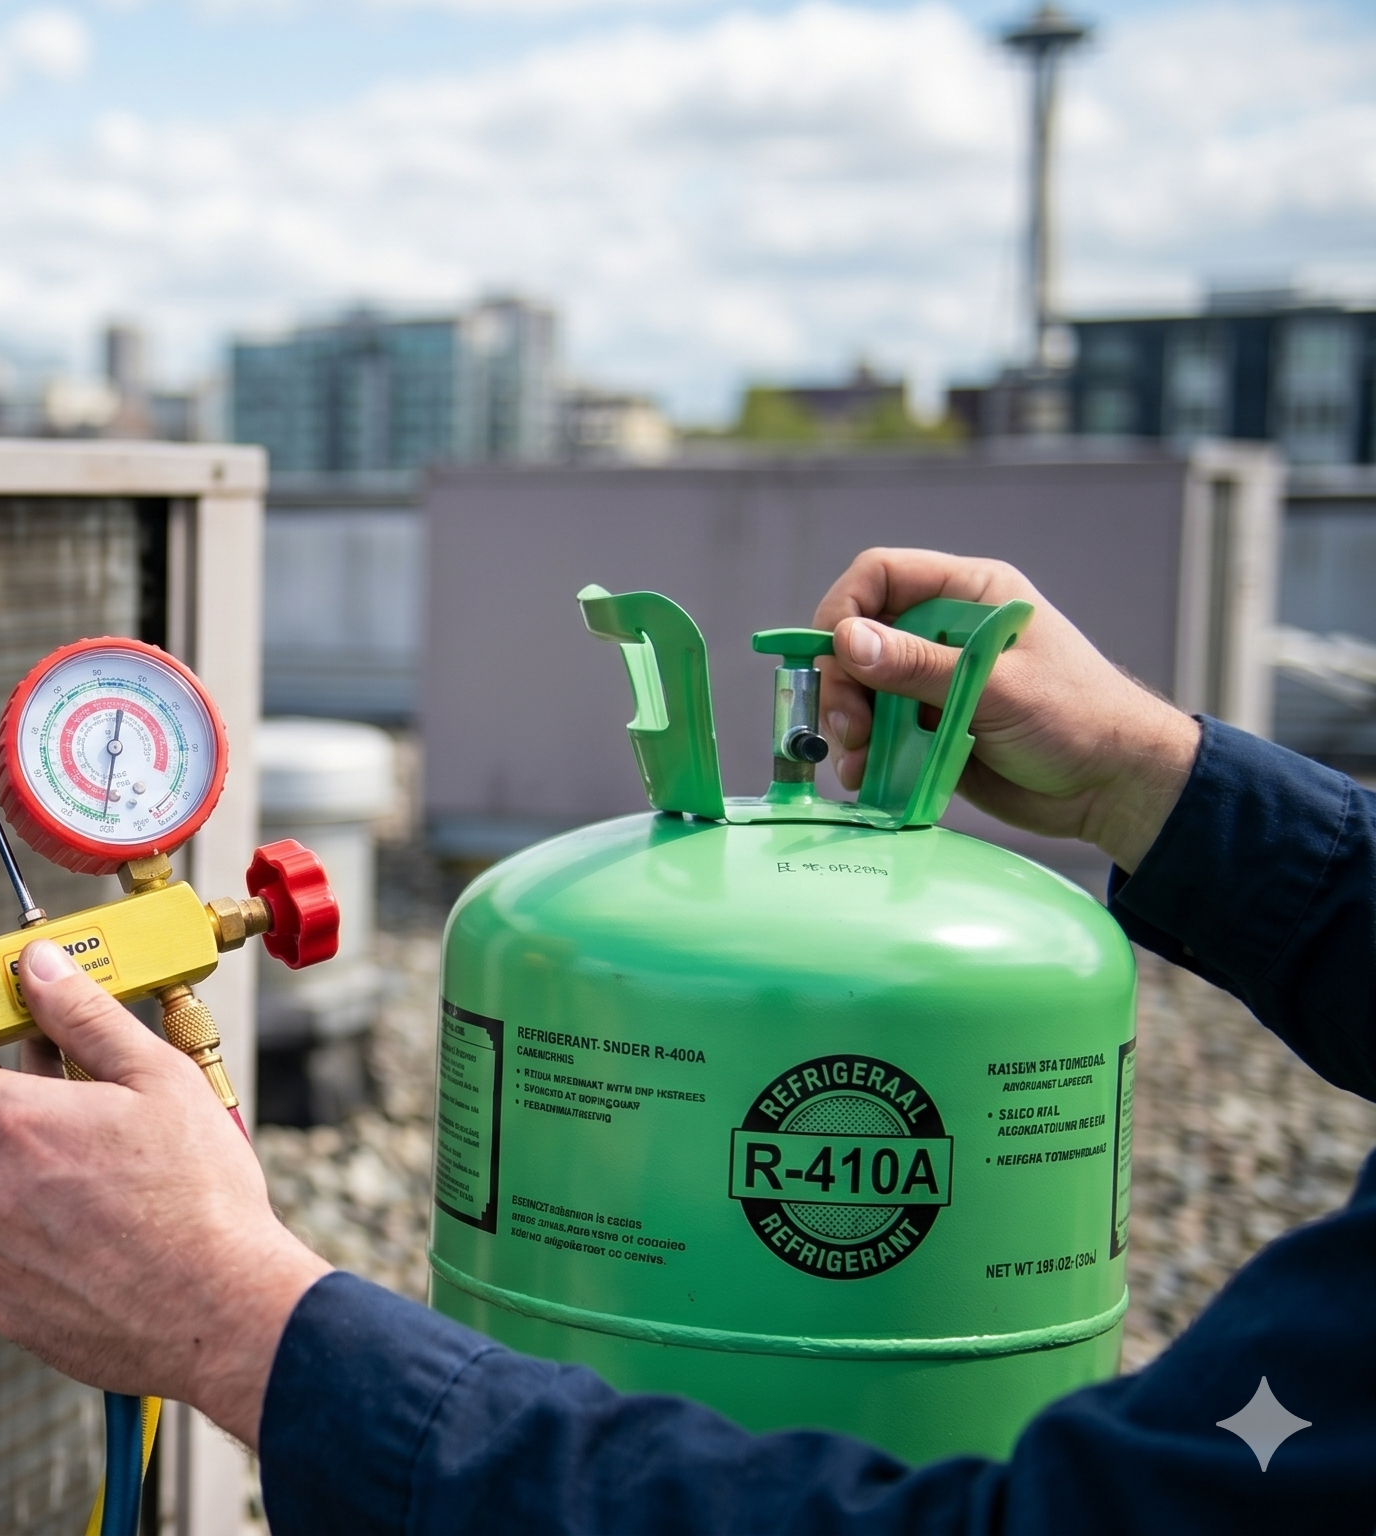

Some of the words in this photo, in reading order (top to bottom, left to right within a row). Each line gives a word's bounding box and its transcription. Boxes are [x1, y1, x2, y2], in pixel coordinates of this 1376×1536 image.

[603, 1039, 650, 1058] SNDER
[654, 1046, 706, 1064] R-400A
[565, 1091, 577, 1101] AT
[758, 1061, 928, 1124] REFRIGERAAL
[744, 1141, 940, 1195] R-410A
[759, 1212, 920, 1273] REFRIGERANT
[986, 1263, 1011, 1279] NET
[1014, 1261, 1035, 1277] WT
